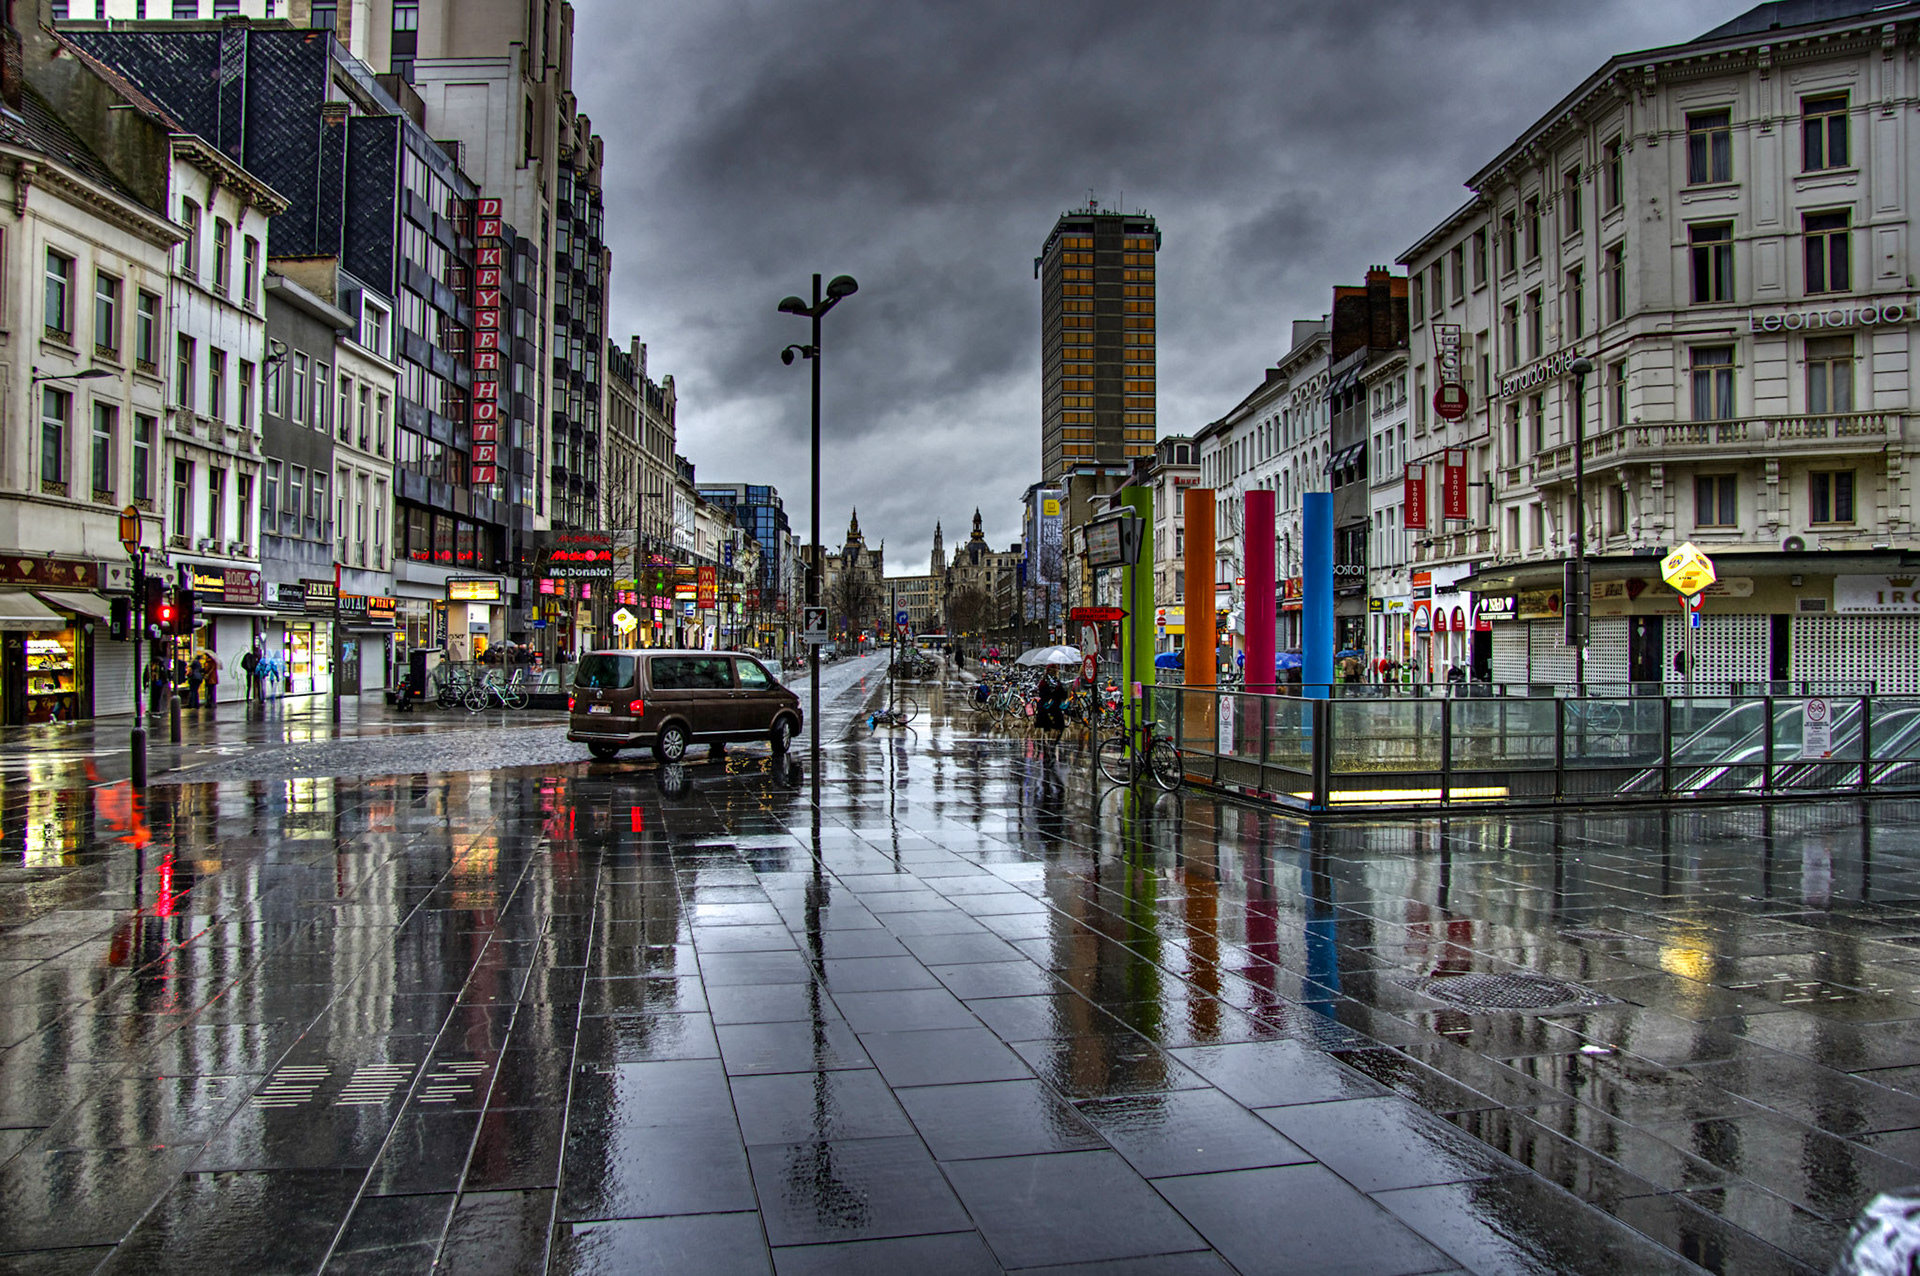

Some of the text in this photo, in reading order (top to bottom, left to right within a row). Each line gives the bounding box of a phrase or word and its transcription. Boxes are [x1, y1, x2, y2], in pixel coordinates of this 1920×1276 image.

[1749, 299, 1903, 333] Leonardo
[476, 200, 499, 483] DE KEYSER HOTEL
[1442, 327, 1459, 384] HOTEL
[1499, 347, 1575, 398] Leonardo Hotel
[308, 583, 334, 596] JENNY
[339, 596, 366, 610] ROYAL
